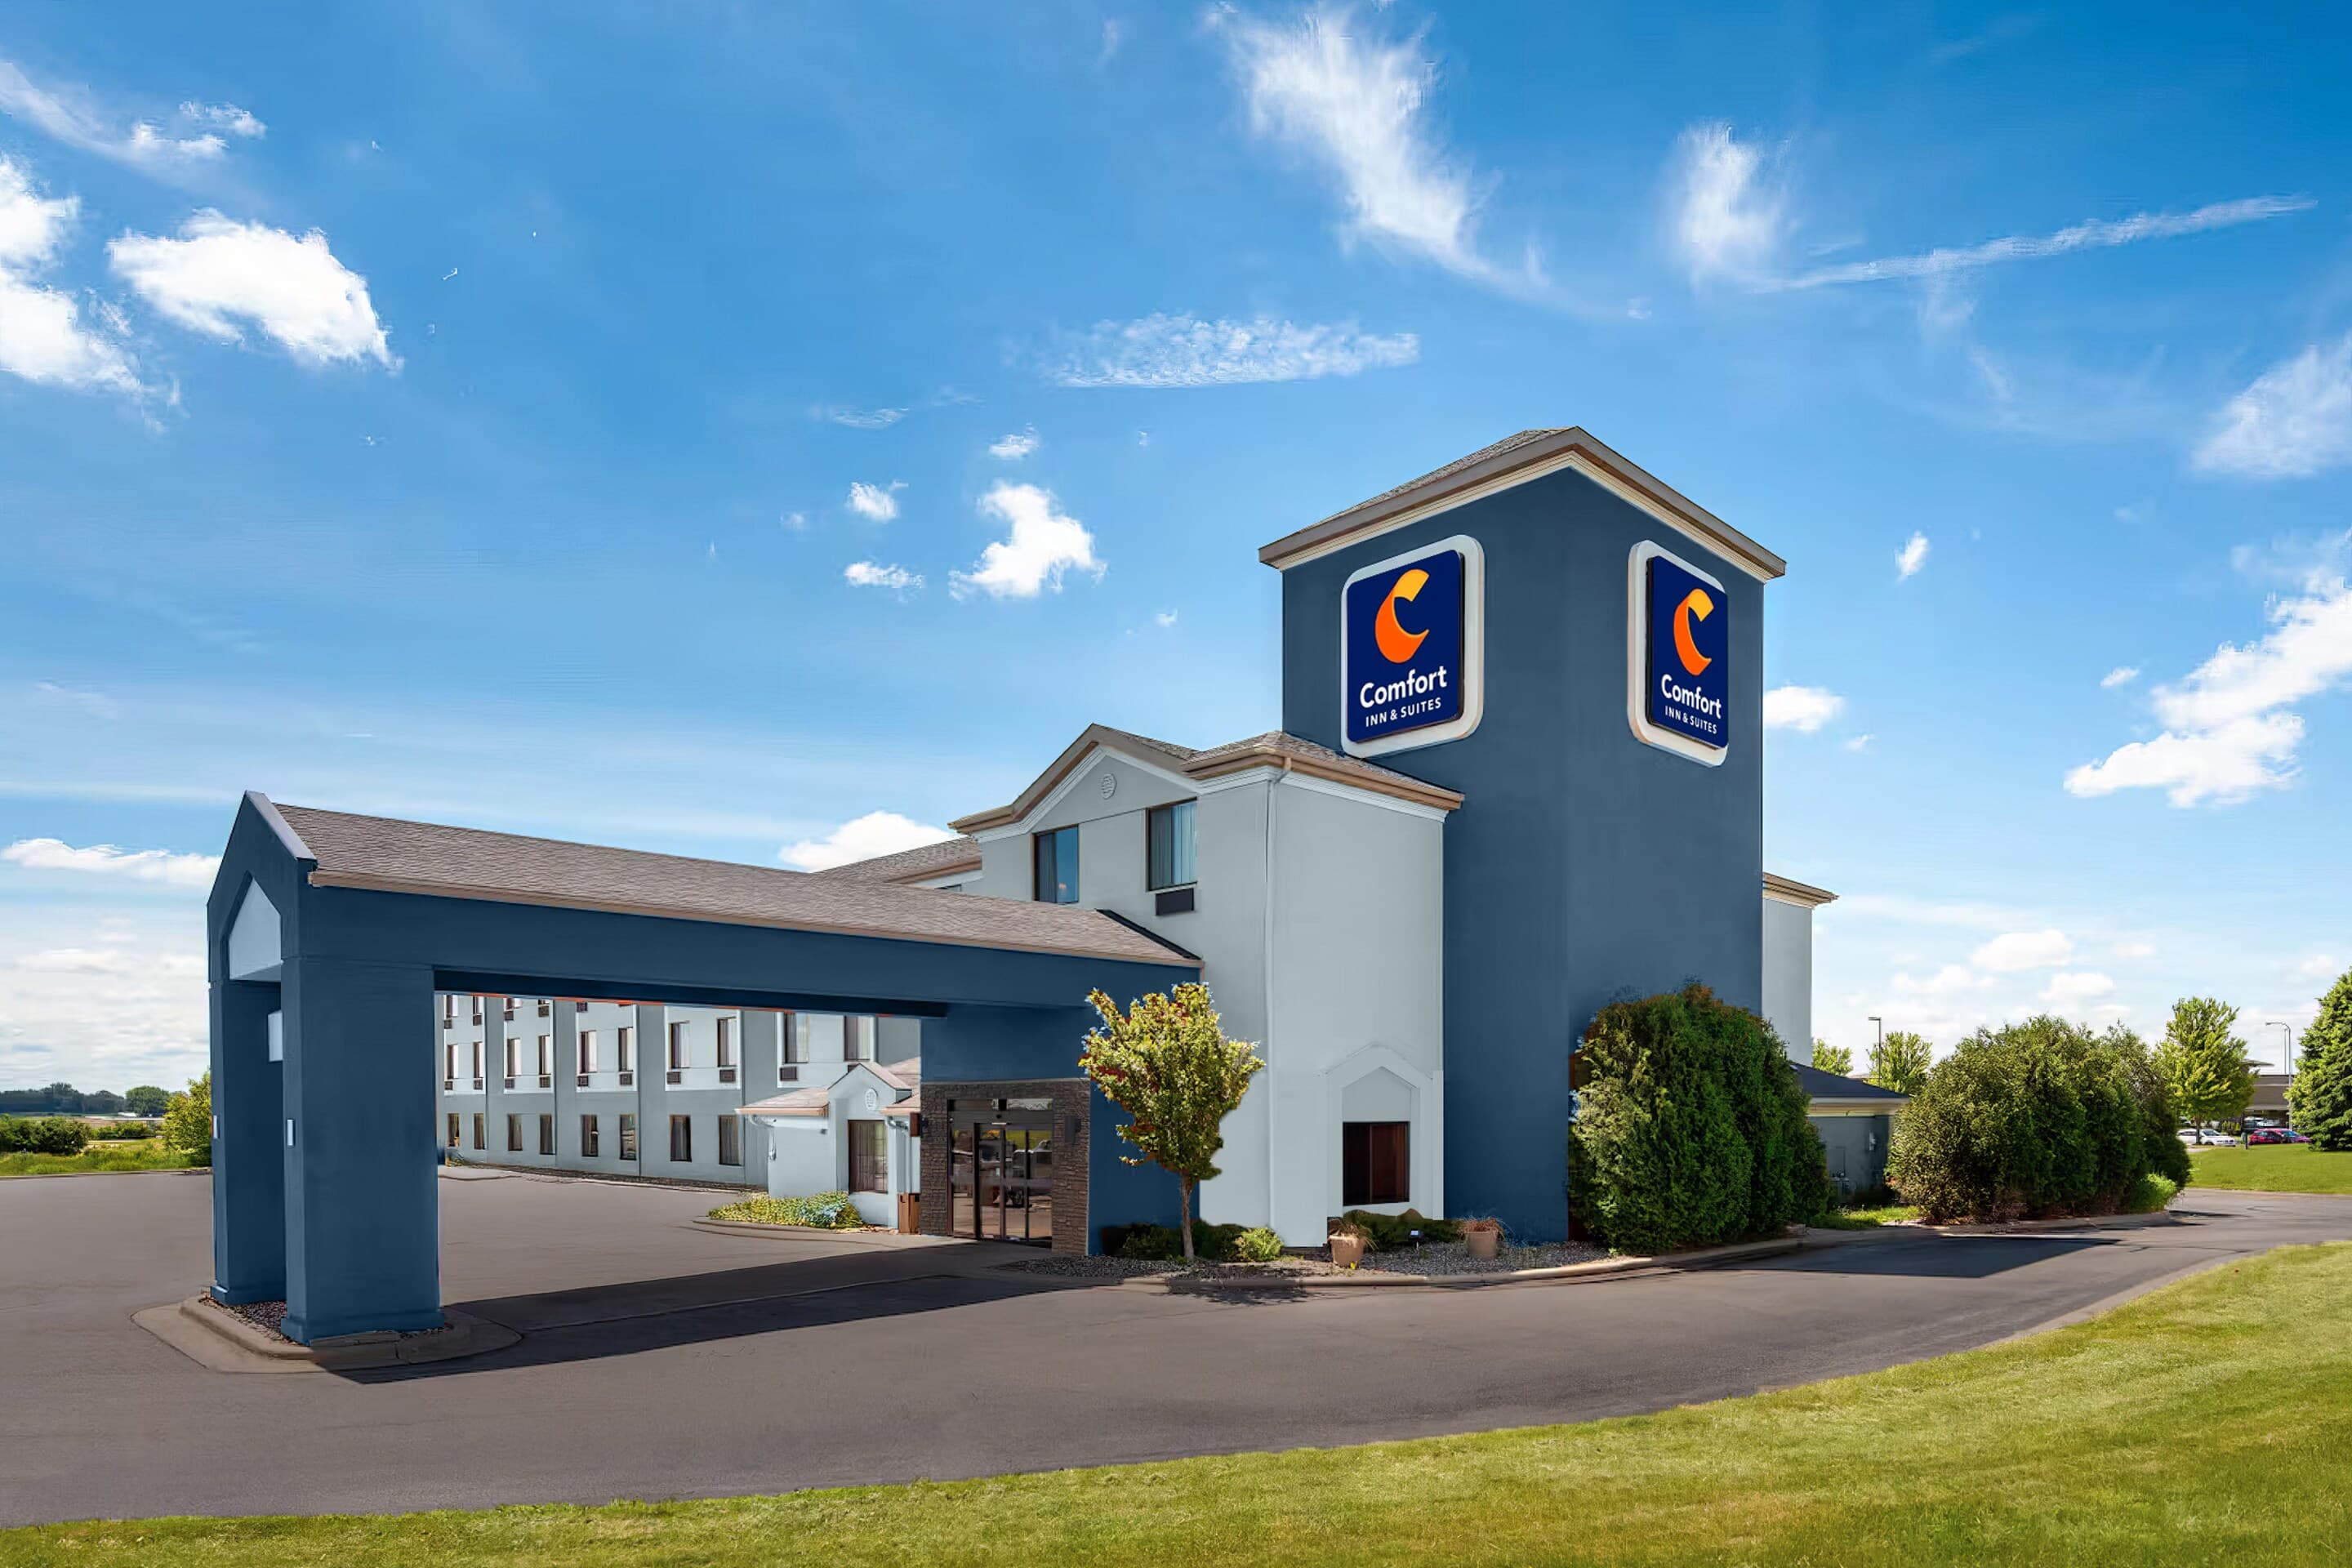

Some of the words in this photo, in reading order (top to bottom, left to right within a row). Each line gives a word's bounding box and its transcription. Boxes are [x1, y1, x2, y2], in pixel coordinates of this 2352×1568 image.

[1360, 666, 1447, 708] Comfort
[1661, 674, 1722, 719] Comfort
[1365, 711, 1388, 728] INN
[1389, 709, 1398, 721] &
[1401, 697, 1441, 718] SUITES
[1664, 705, 1682, 720] INN
[1682, 712, 1689, 724] &
[1690, 715, 1717, 734] SUITES
